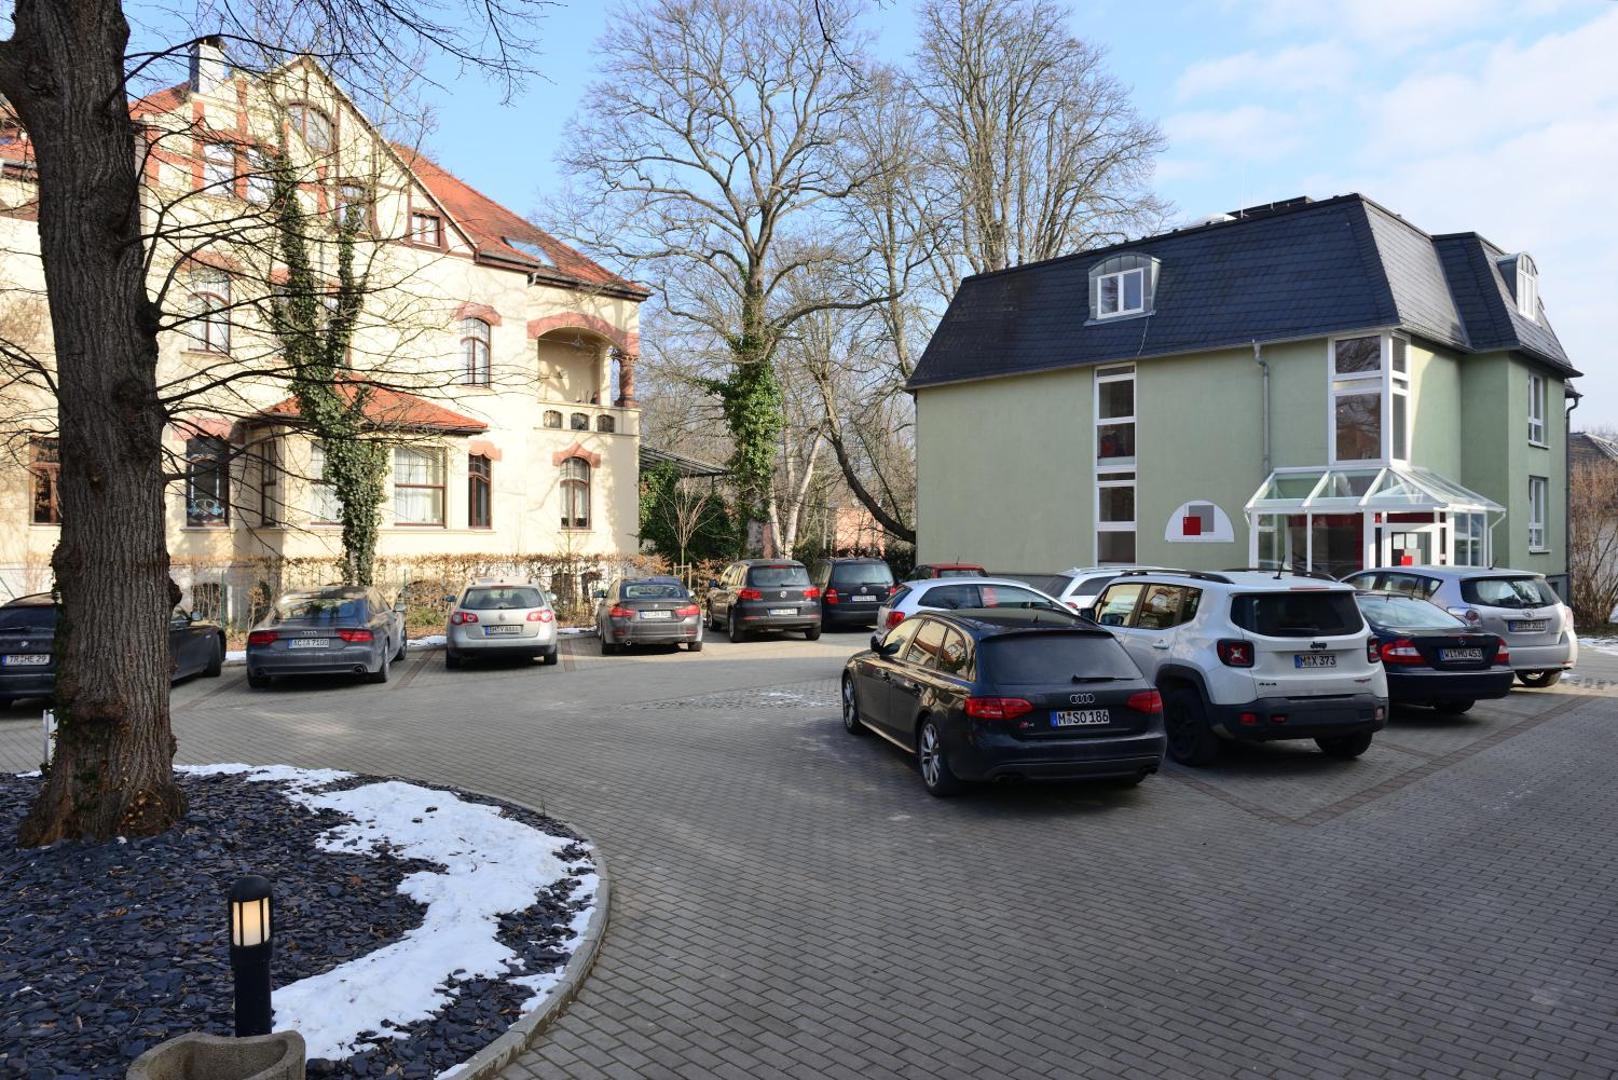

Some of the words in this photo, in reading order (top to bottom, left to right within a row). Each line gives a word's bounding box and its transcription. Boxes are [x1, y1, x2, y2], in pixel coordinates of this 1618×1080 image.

[1319, 655, 1336, 666] 373
[1057, 712, 1066, 725] M
[1072, 711, 1087, 724] SO
[1089, 710, 1109, 723] 186
